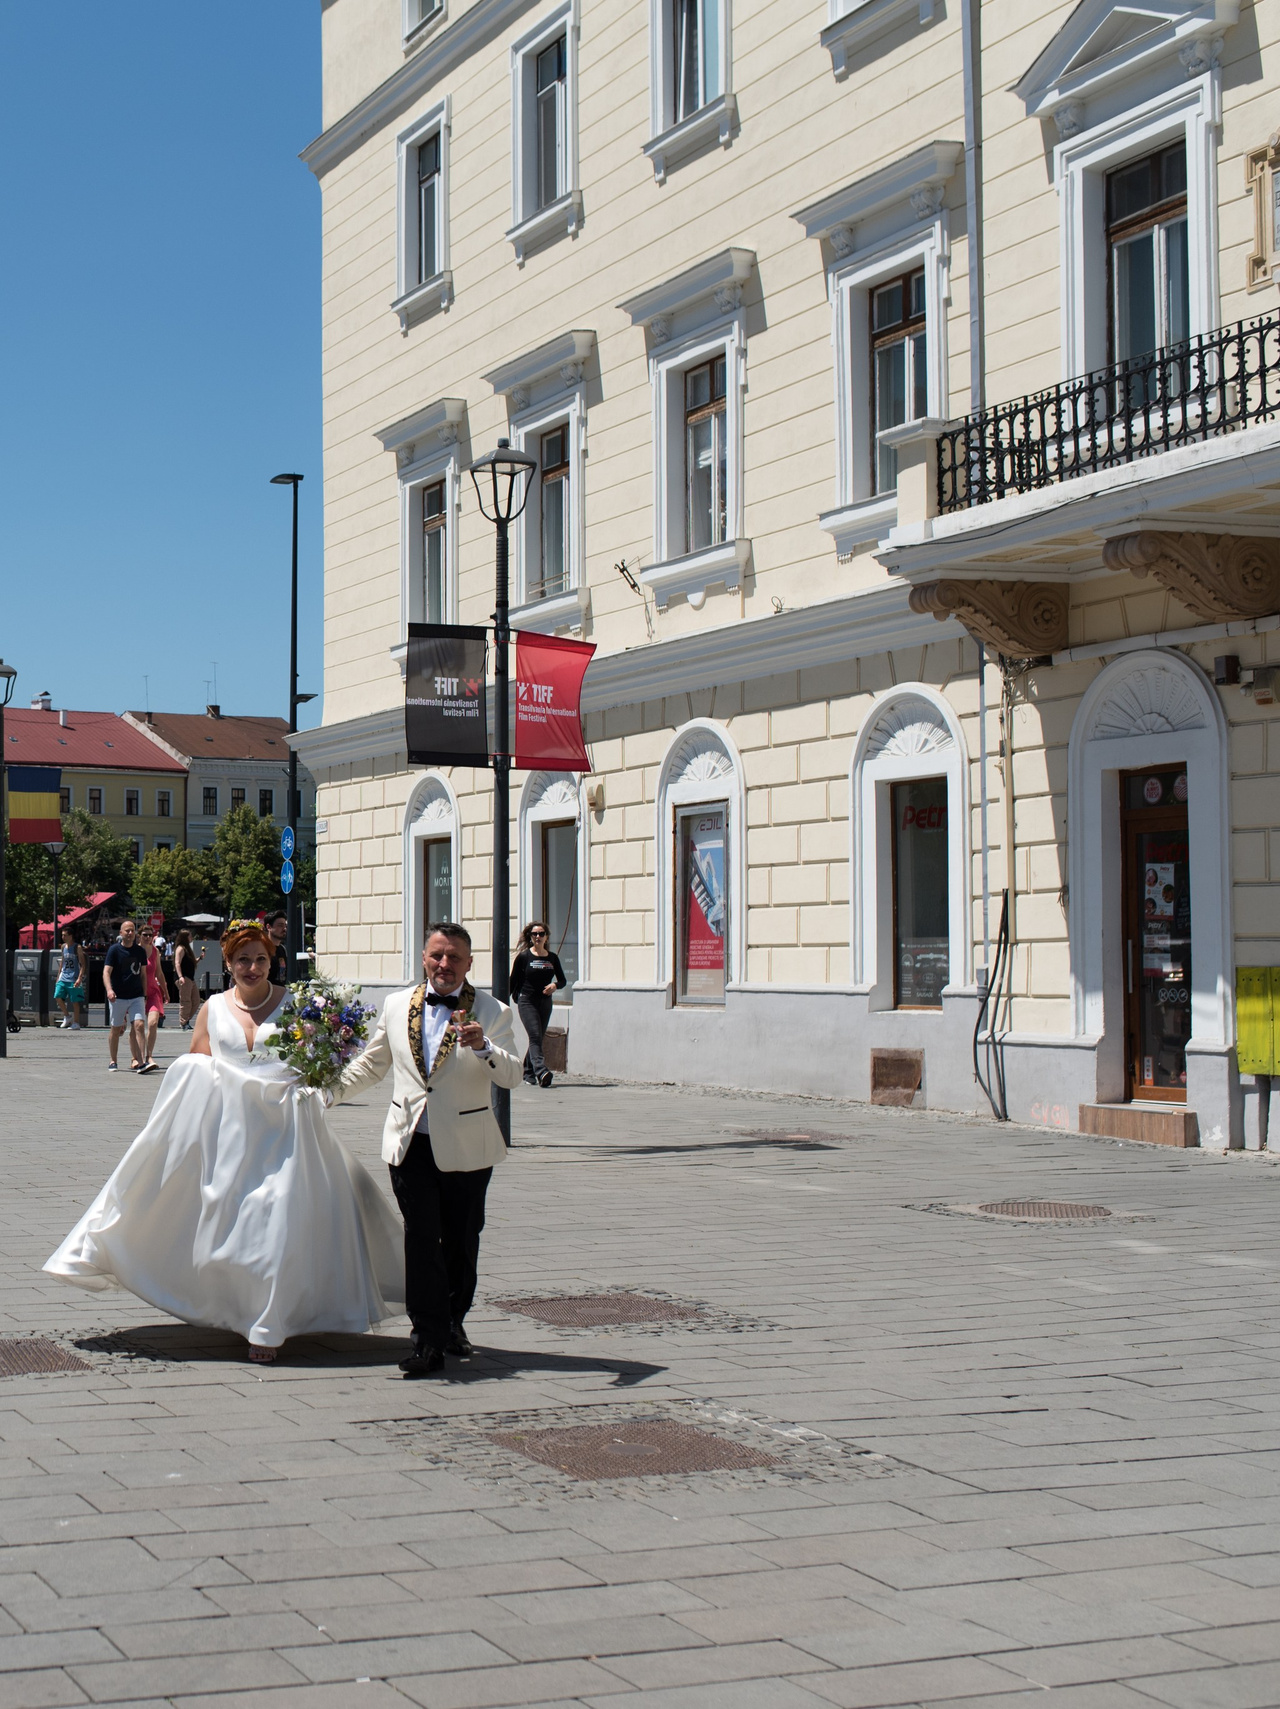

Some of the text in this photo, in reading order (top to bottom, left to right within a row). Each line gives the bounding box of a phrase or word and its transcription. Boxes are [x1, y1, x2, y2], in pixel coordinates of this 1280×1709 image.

[532, 683, 554, 704] TIFF
[518, 703, 577, 717] Transilvania International
[518, 712, 548, 723] Film Festival
[901, 805, 948, 831] Petr
[65, 960, 75, 969] 22
